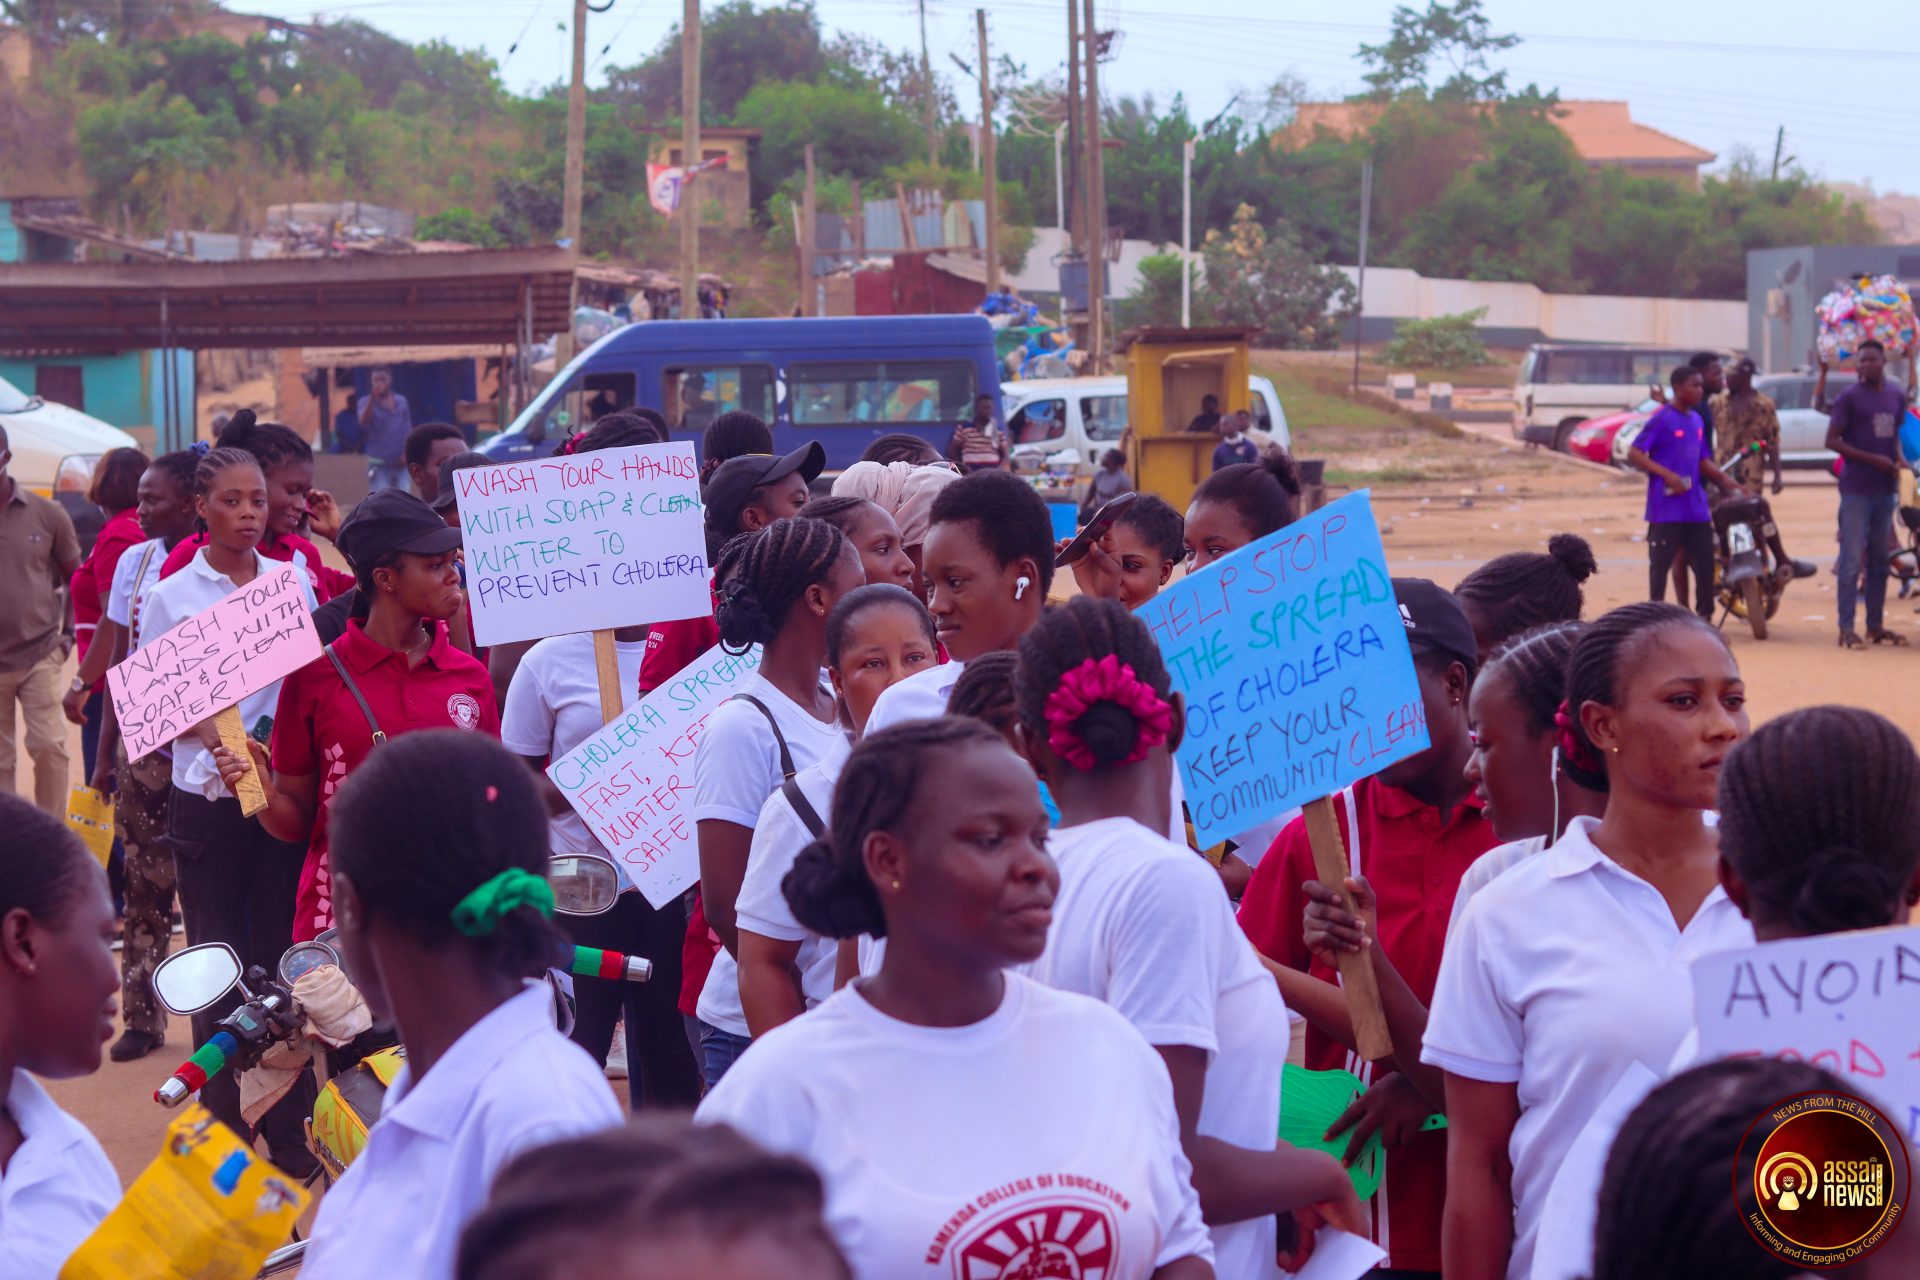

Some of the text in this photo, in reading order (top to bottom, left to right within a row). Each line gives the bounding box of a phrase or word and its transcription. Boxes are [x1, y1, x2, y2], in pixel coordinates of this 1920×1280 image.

[457, 453, 696, 498] WASH YOUR HANDS
[463, 503, 534, 536] WITH
[543, 490, 616, 524] SOAP
[621, 491, 634, 516] &
[471, 529, 625, 575] WATER TO
[477, 553, 705, 608] PREVENT CHOLERA
[1145, 514, 1347, 644] HELP STOP
[116, 595, 304, 716] HANDS WITH
[118, 569, 297, 688] WASH YOUR
[1167, 557, 1390, 692] THE SPREAD
[122, 614, 305, 738] SOAP & CLEAN
[1184, 622, 1385, 739] OF CHOLERA
[554, 703, 667, 790] CHOLERA
[1186, 686, 1365, 790] KEEP YOUR
[577, 760, 652, 820] FAST,
[600, 774, 695, 846] WATER
[1195, 738, 1341, 831] COMMUNITY
[624, 813, 689, 873] SAFE
[975, 1176, 1034, 1209] COLLEGE
[1036, 1172, 1054, 1188] OF
[1057, 1172, 1132, 1213] EDUCATION
